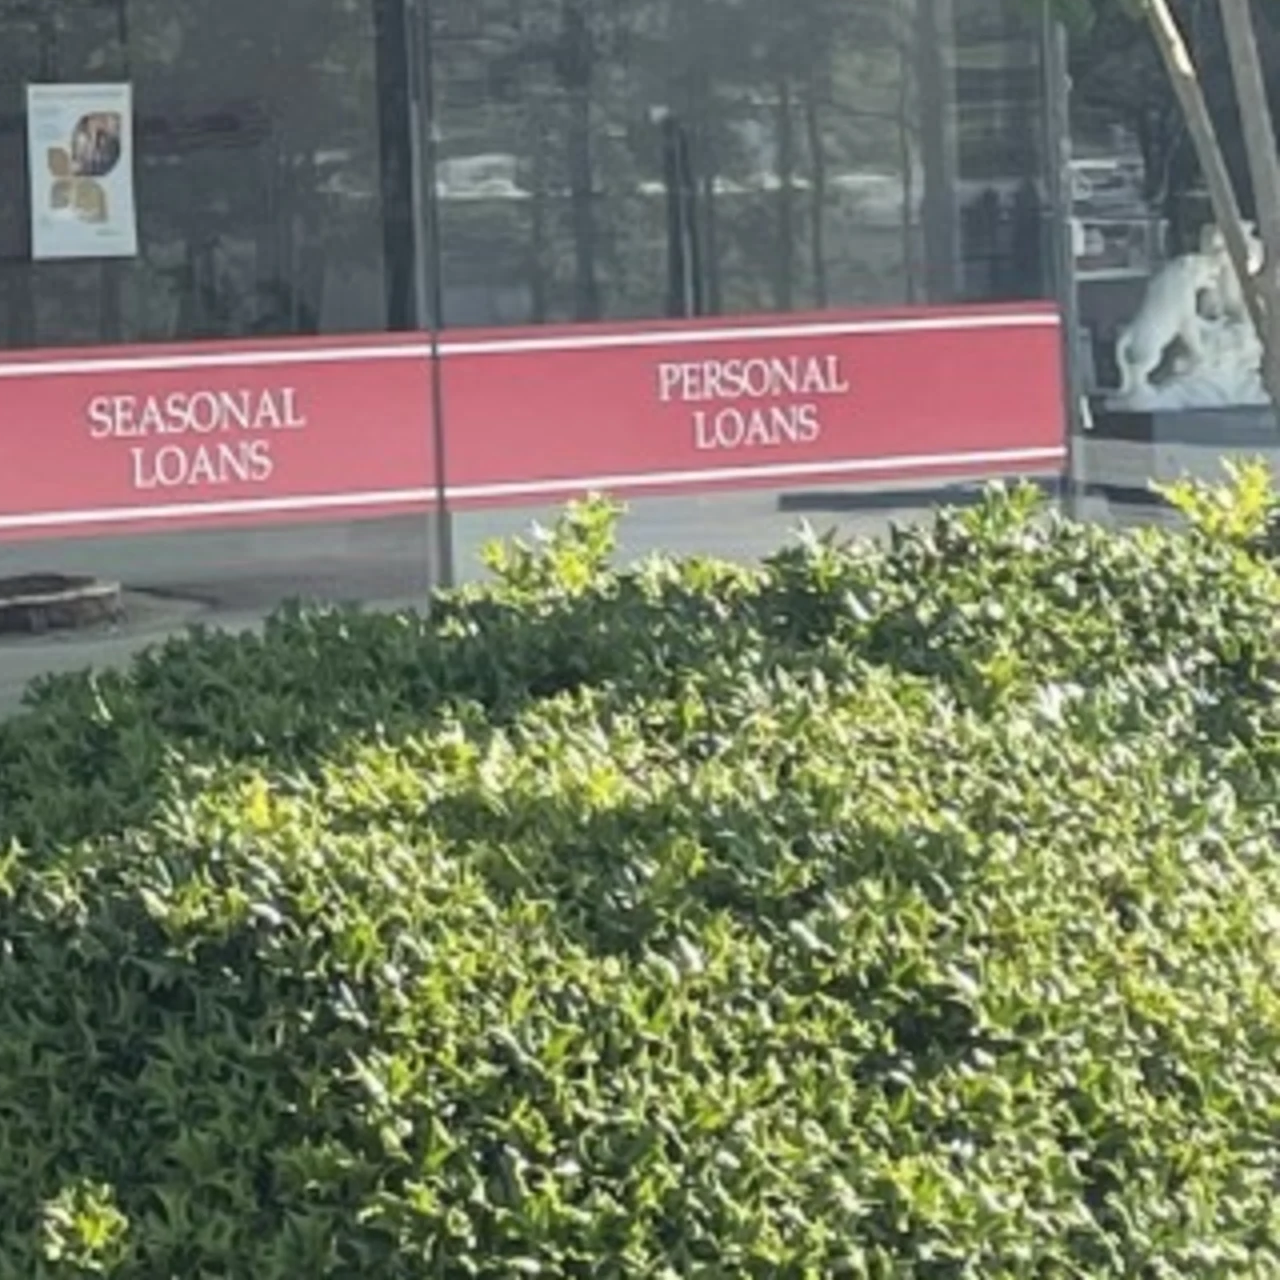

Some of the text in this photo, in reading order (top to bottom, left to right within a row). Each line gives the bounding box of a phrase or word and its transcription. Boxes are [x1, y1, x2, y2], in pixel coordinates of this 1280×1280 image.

[658, 355, 849, 402] PERSONAL
[88, 387, 307, 438] SEASONAL
[693, 404, 820, 450] LOANS
[131, 440, 273, 489] LOANS
